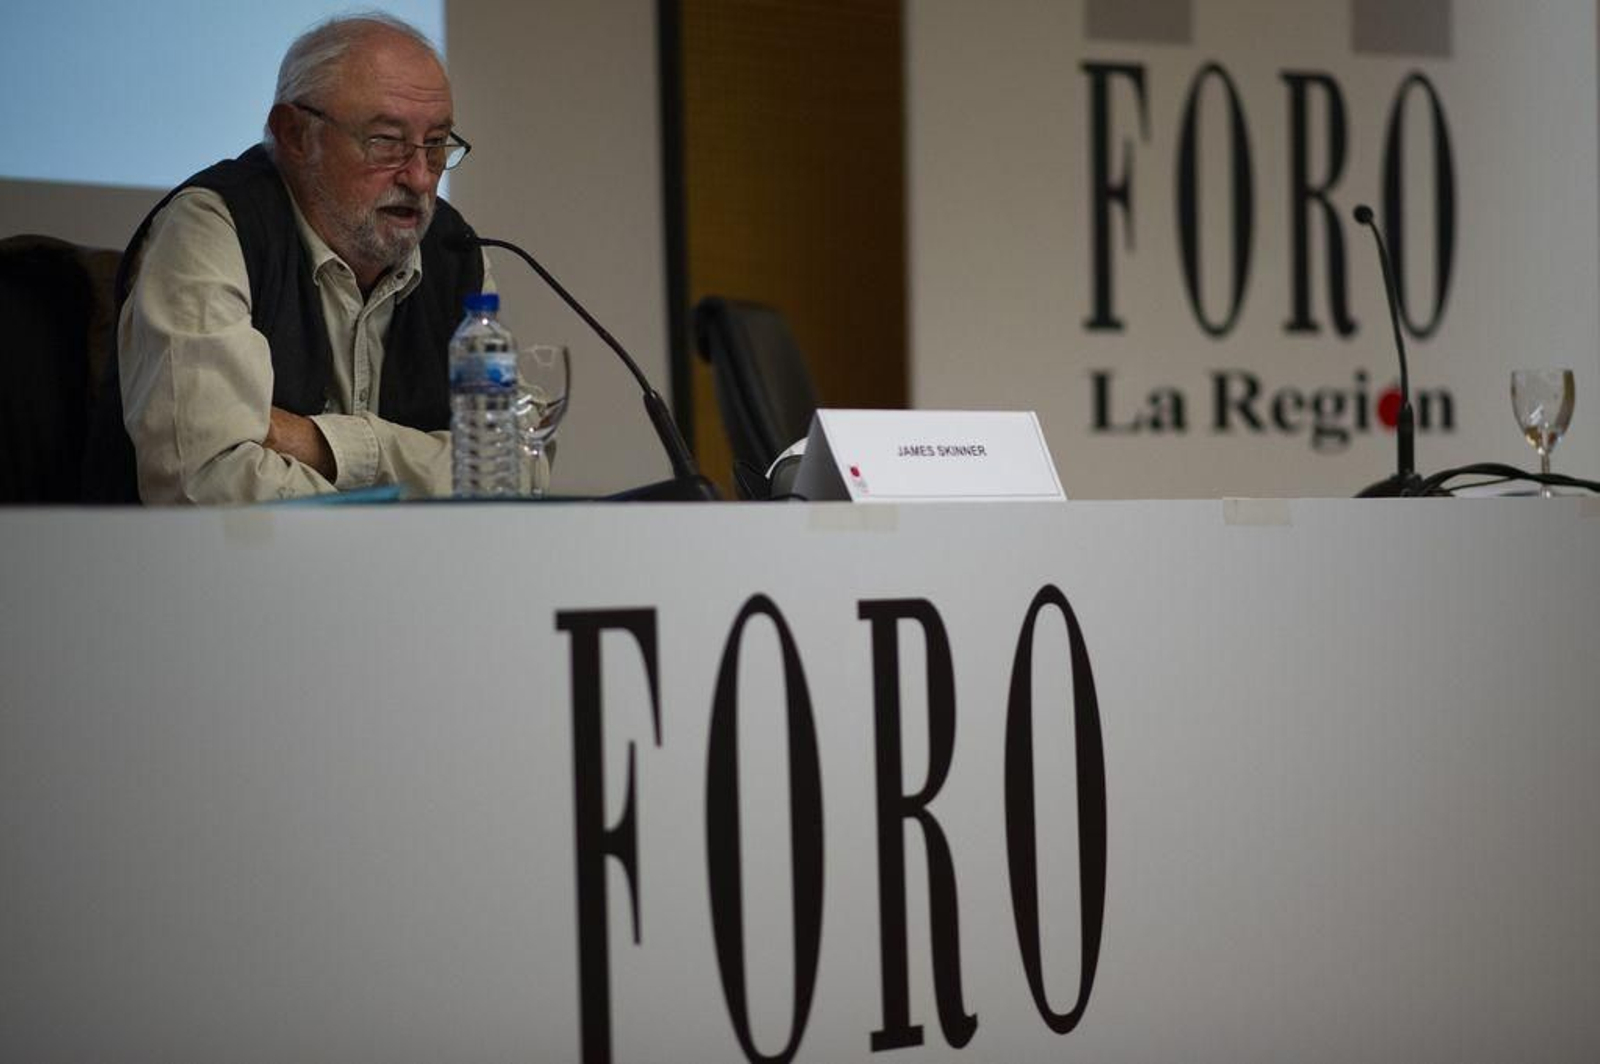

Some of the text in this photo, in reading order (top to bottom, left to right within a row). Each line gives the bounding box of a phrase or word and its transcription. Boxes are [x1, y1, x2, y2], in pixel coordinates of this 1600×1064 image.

[1080, 60, 1457, 340] FORO
[898, 445, 987, 457] JAMES SKINNER
[1092, 371, 1187, 433] La
[555, 584, 1107, 1064] FORO
